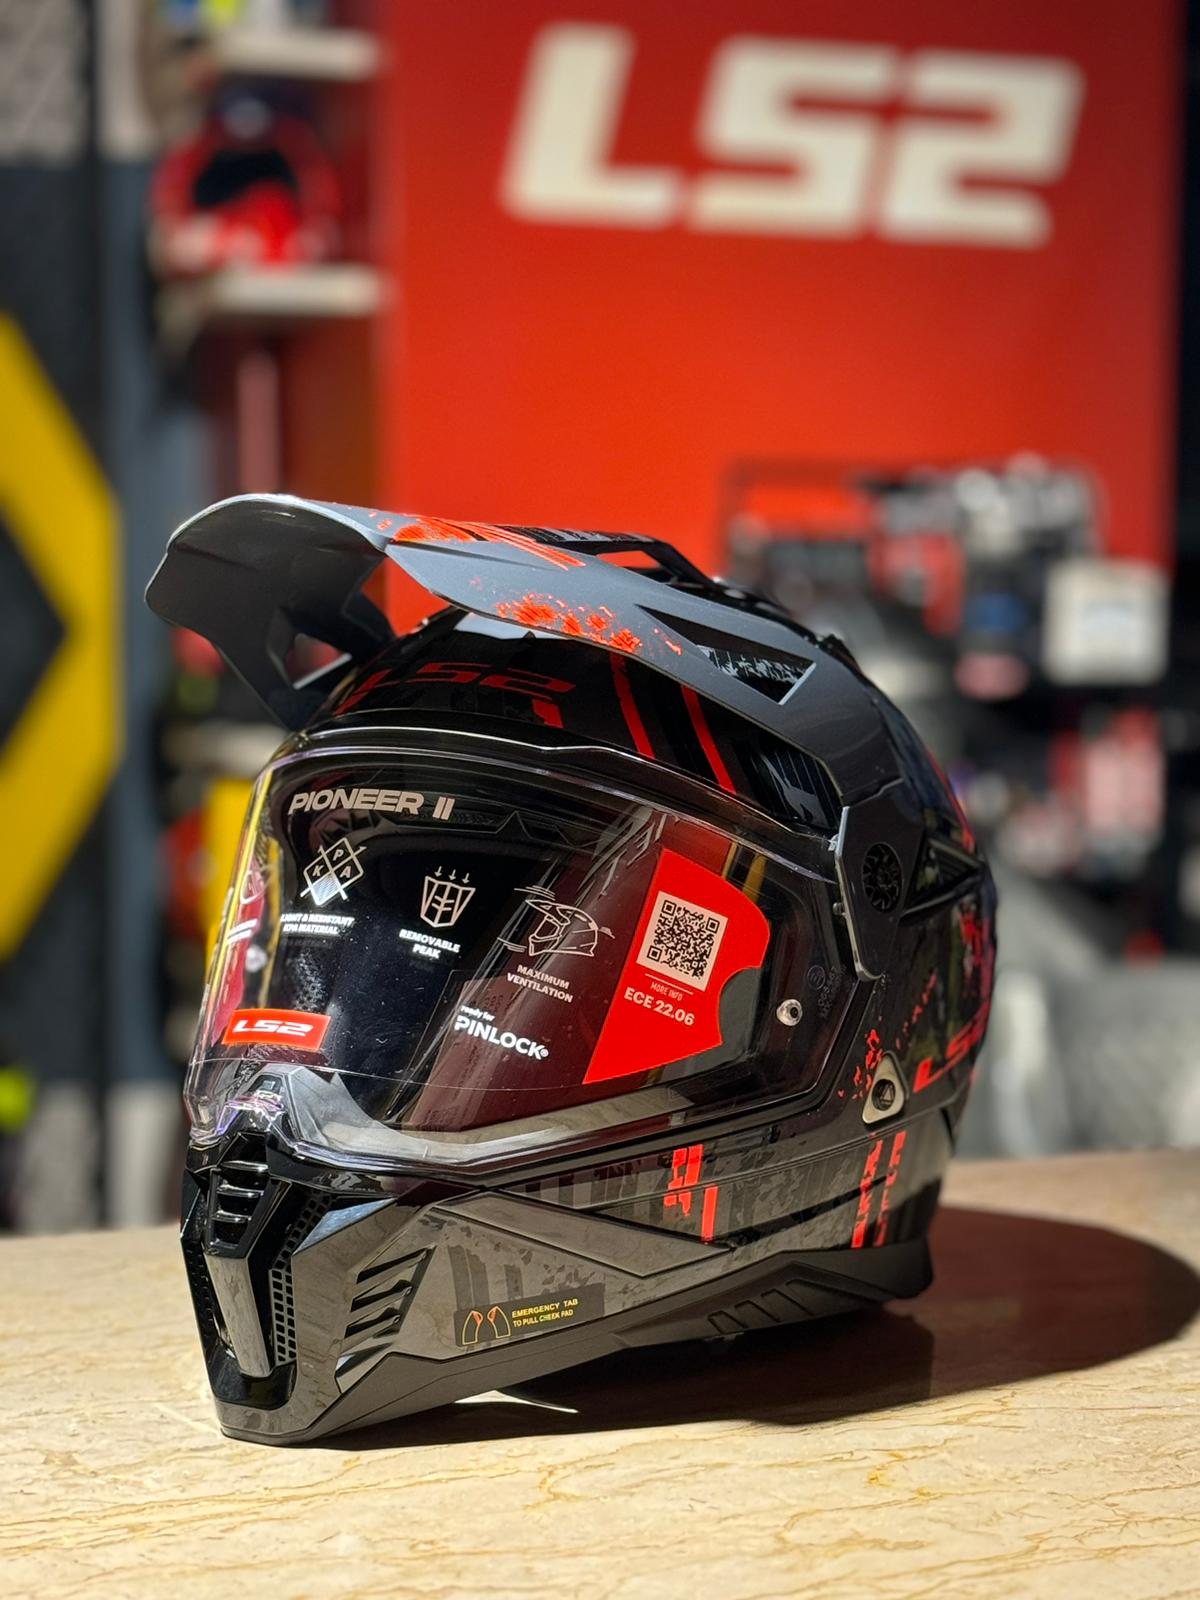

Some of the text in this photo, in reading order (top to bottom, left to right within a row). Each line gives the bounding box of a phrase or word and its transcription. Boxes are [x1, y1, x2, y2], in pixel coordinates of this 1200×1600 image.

[498, 21, 1084, 249] LS2
[288, 788, 424, 815] PIONEER
[399, 928, 461, 953] REMOVABLE
[412, 943, 441, 960] PEAK
[507, 973, 573, 1003] VENTILATION
[517, 964, 570, 990] MAXIMUM
[650, 981, 683, 1002] MORE INFO
[624, 986, 695, 1026] ECE 22.06
[233, 1019, 314, 1037] LS2
[511, 1298, 578, 1318] EMERGENCY TAB
[513, 1308, 574, 1328] TO PULL CHEEK PAD
